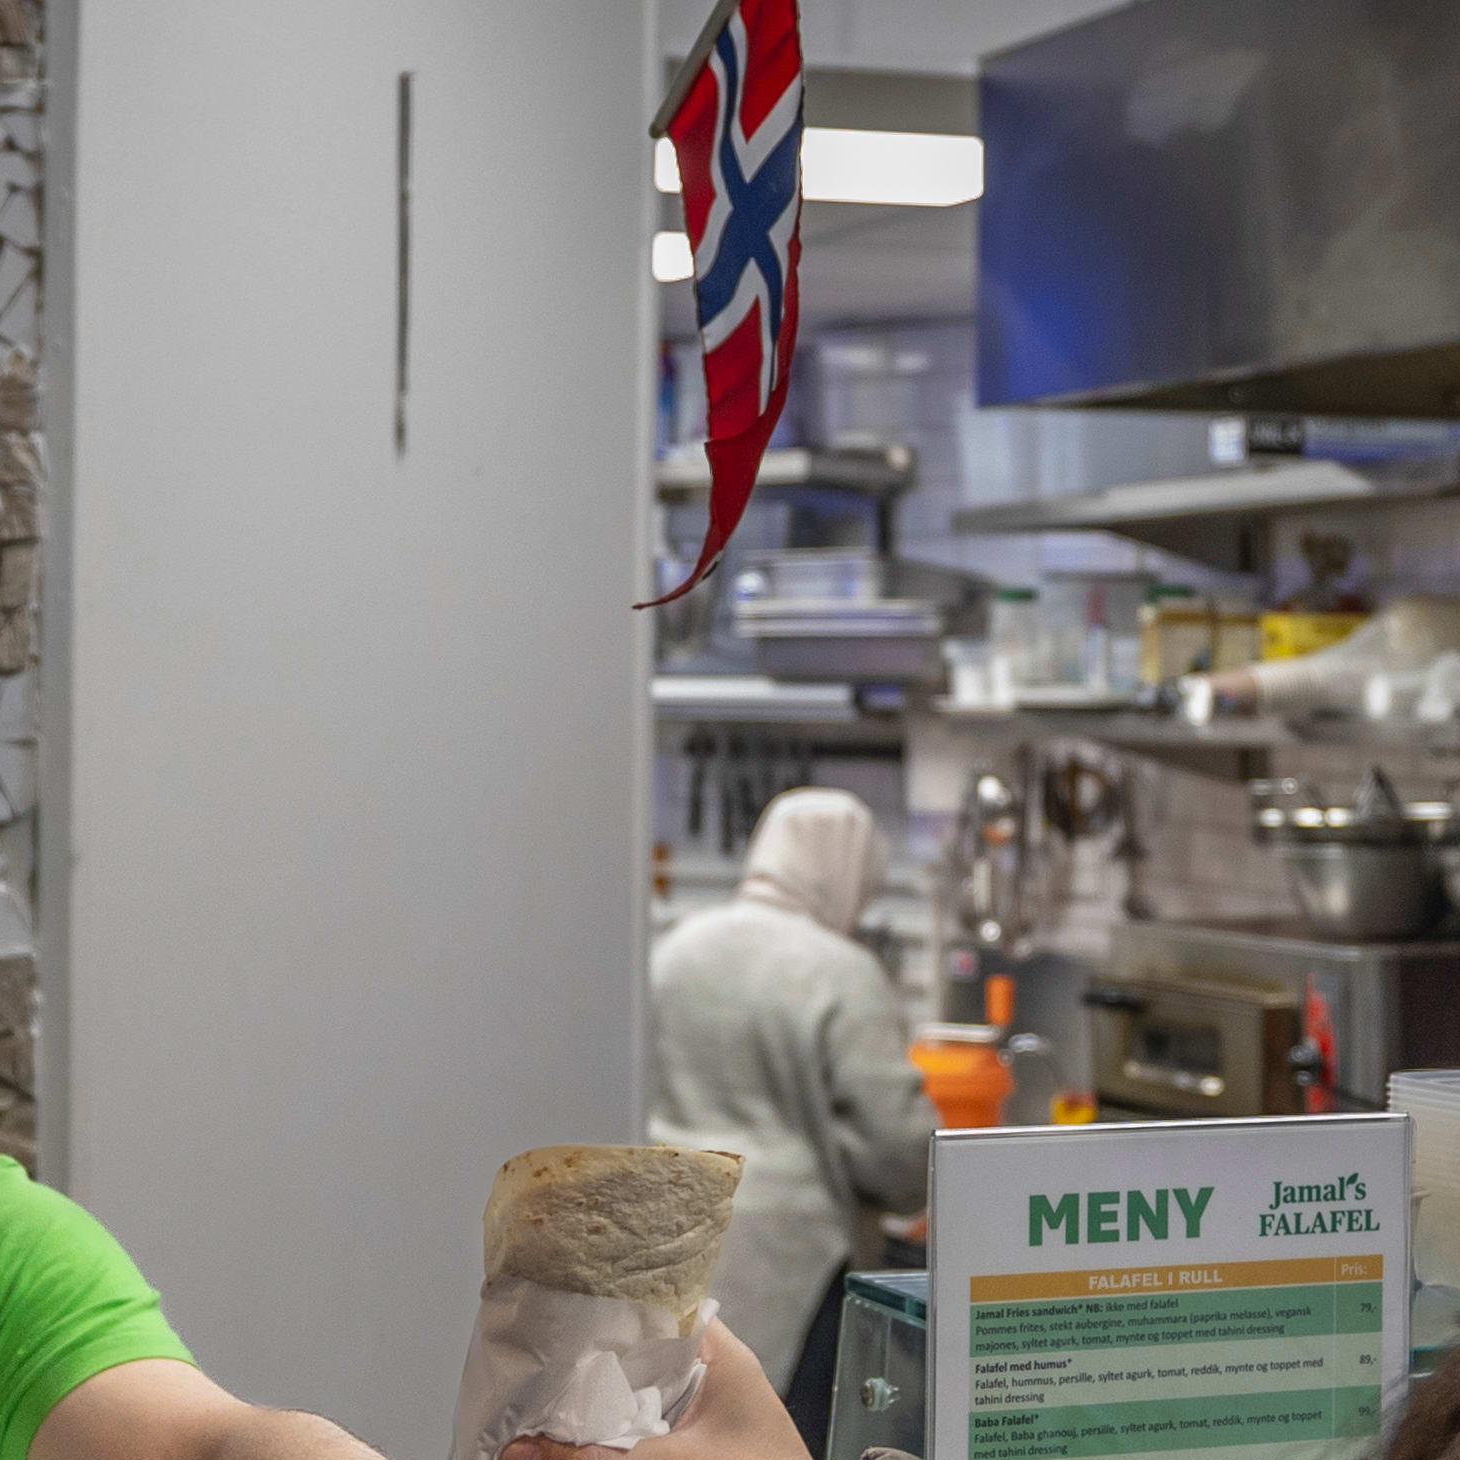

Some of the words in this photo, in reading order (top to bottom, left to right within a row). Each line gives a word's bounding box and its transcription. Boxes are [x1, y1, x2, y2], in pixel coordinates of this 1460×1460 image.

[1268, 1173, 1367, 1210] Jamal's
[1028, 1186, 1215, 1246] MENY
[1258, 1208, 1381, 1238] FALAFEL
[1088, 1272, 1163, 1289] FALAFEL
[1167, 1271, 1173, 1284] I
[1178, 1268, 1222, 1284] RULL
[1340, 1262, 1367, 1275] Pris:
[975, 1309, 1004, 1319] Jamal
[1006, 1307, 1029, 1317] Fries
[1085, 1303, 1102, 1313] NB:
[1105, 1302, 1124, 1311] ikke
[1126, 1300, 1147, 1310] med
[1150, 1299, 1178, 1309] falafel
[976, 1324, 1017, 1335] Pommes
[1049, 1320, 1072, 1330] stekt
[1127, 1313, 1187, 1326] muhammara
[1275, 1306, 1310, 1319] vegansk
[1021, 1338, 1047, 1351] syltet
[1115, 1332, 1145, 1345] mynte
[1147, 1334, 1159, 1343] og
[1161, 1330, 1192, 1342] toppet
[1195, 1328, 1215, 1338] med
[1218, 1327, 1244, 1336] tahini
[1246, 1324, 1284, 1337] dressing
[975, 1362, 1007, 1373] Falafel
[1009, 1361, 1031, 1371] med
[1097, 1370, 1123, 1383] syltet
[1224, 1362, 1254, 1375] mynte
[1256, 1364, 1267, 1373] og
[1270, 1359, 1300, 1372] toppet
[1302, 1358, 1323, 1367] med
[975, 1394, 1002, 1404] tahini
[1004, 1392, 1044, 1405] dressing
[974, 1417, 999, 1427] Baba
[1011, 1430, 1034, 1440] Baba
[1120, 1422, 1145, 1435] syltet
[1246, 1413, 1275, 1426] mynte
[1278, 1415, 1289, 1424] og
[1291, 1410, 1321, 1423] toppet
[974, 1448, 995, 1458] med
[998, 1447, 1025, 1457] tahini
[1028, 1444, 1067, 1457] dressing
